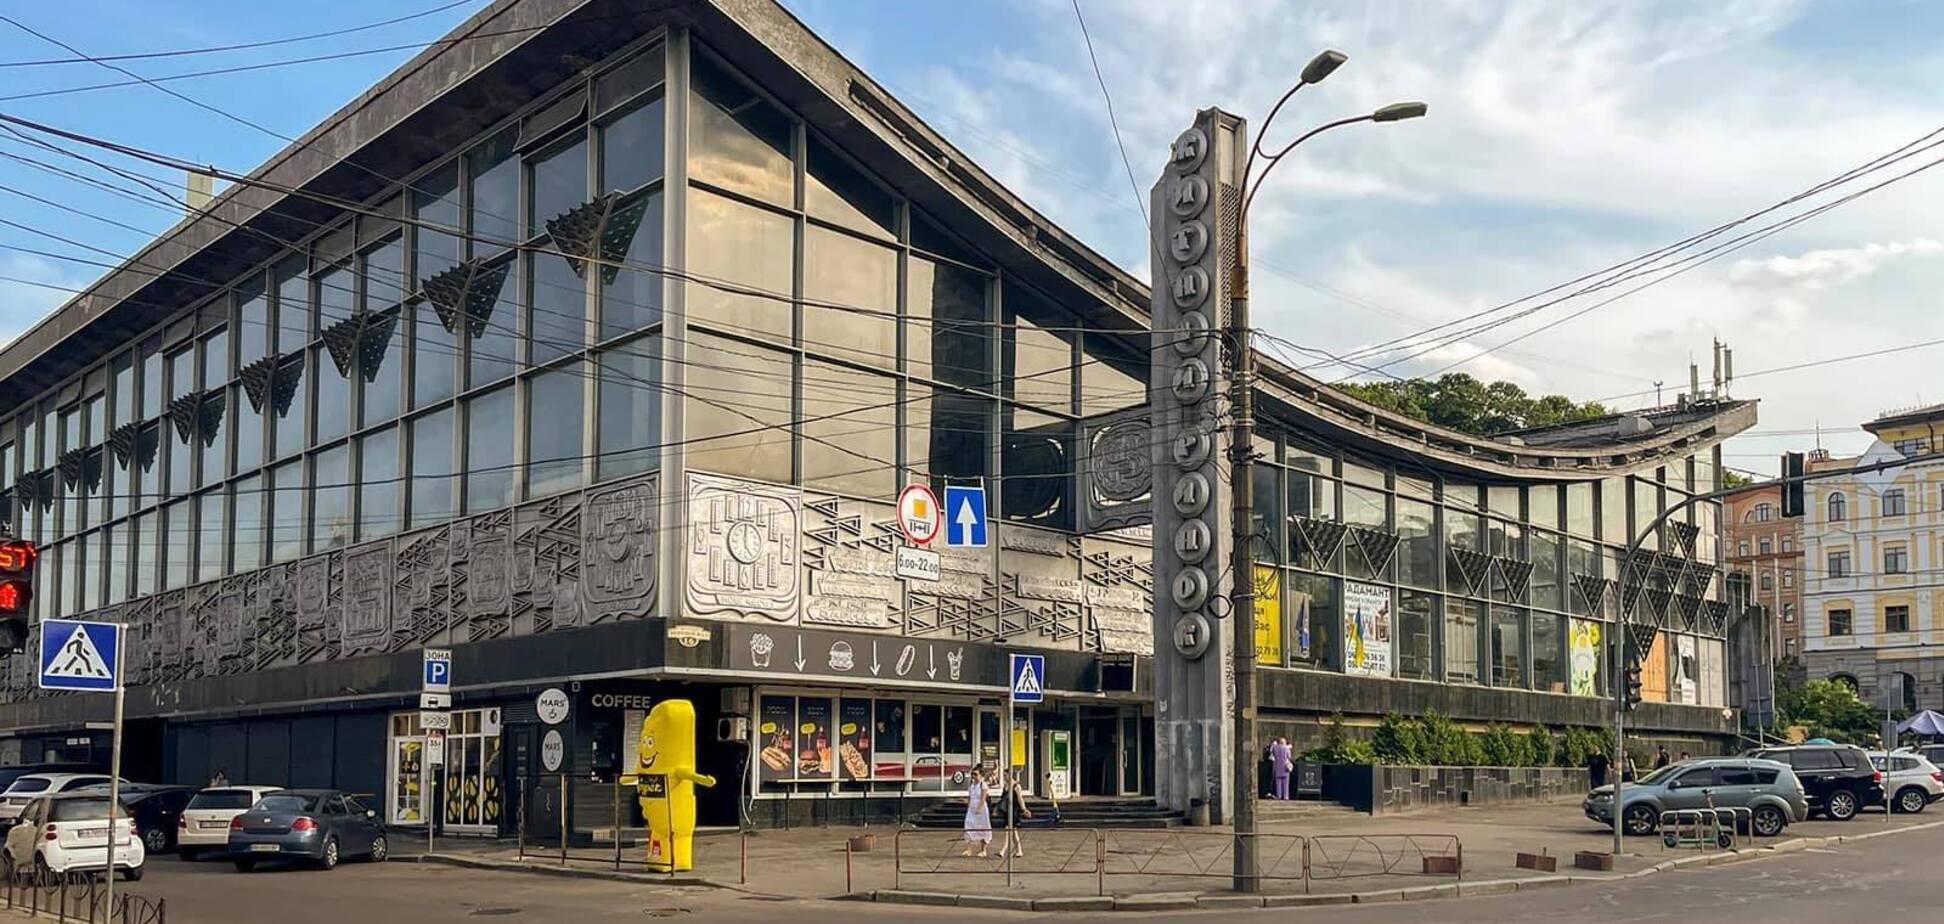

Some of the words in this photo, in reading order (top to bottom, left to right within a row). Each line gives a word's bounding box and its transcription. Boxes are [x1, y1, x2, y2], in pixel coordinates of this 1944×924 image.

[426, 651, 450, 660] ЗОНА
[541, 698, 565, 708] MARS
[592, 693, 651, 709] COFFEE
[544, 742, 561, 751] MARS
